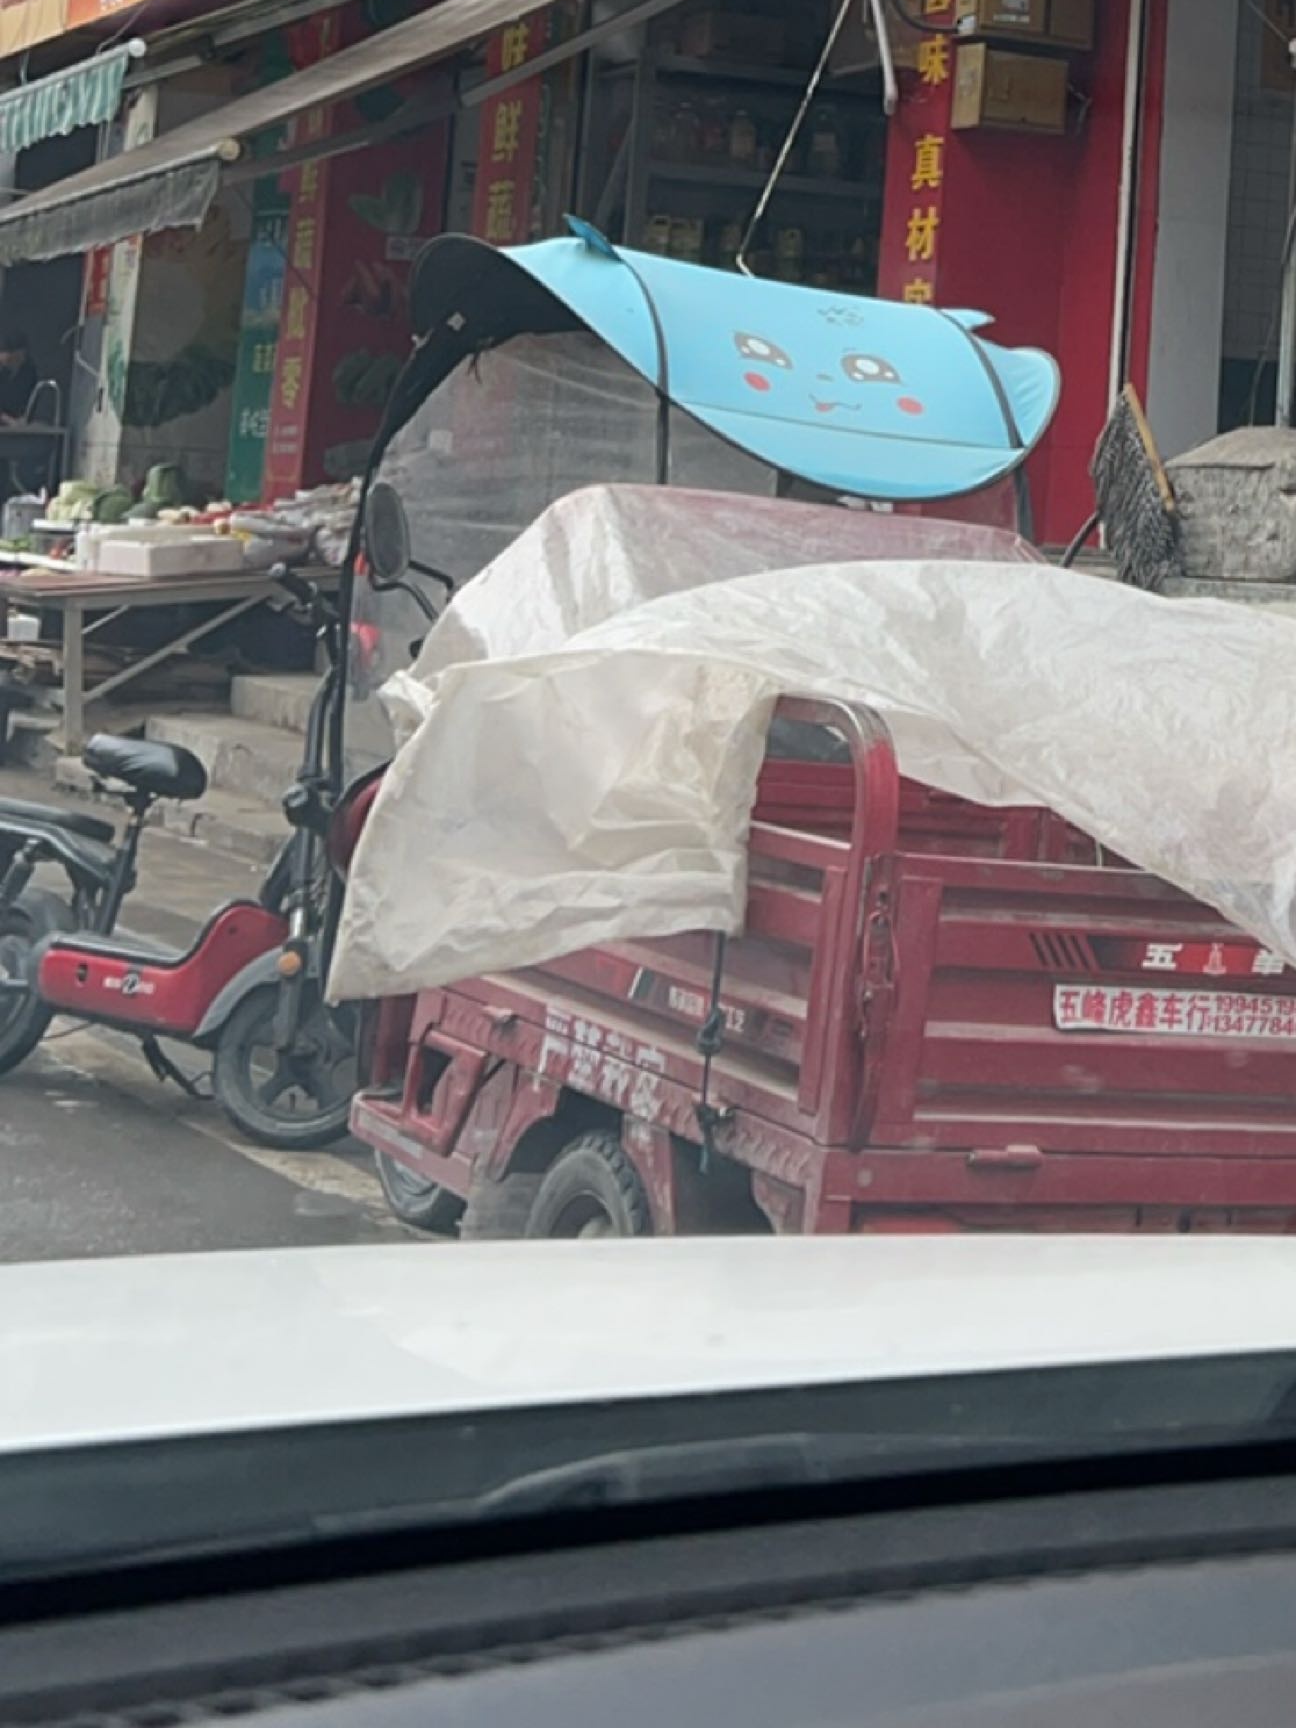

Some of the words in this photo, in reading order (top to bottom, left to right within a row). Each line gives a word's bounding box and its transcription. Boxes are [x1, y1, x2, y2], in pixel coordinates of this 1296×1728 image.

[1059, 989, 1210, 1031] 五峰虎鑫车行
